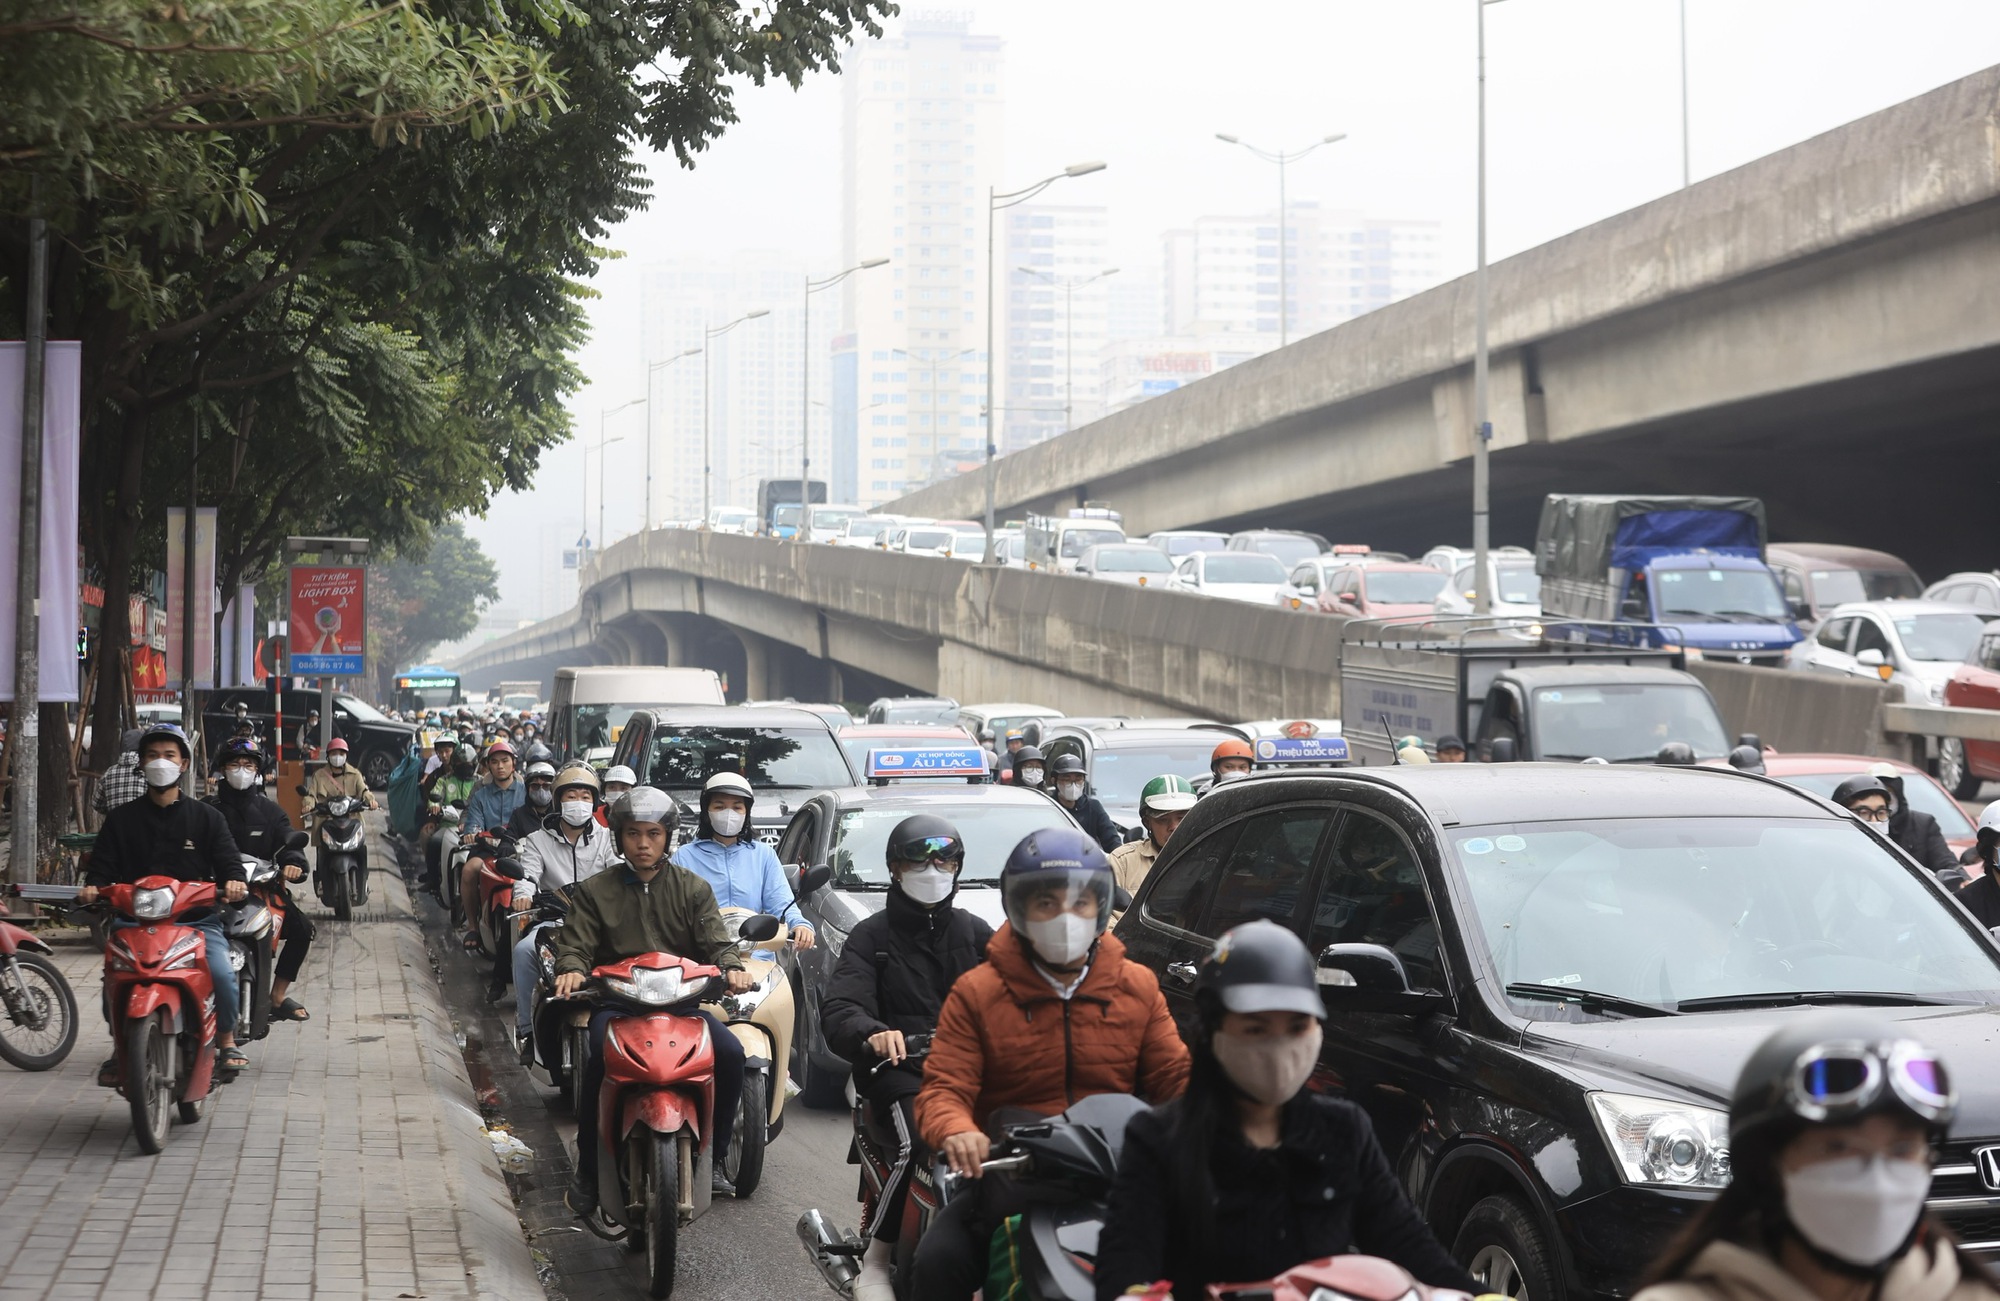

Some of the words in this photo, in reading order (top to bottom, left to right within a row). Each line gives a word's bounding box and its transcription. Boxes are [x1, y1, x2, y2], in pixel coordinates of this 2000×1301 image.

[298, 587, 332, 598] LIGHT
[331, 586, 357, 596] BOX
[1301, 740, 1320, 748] TAXI
[1278, 748, 1302, 758] TRIỆU
[1303, 746, 1327, 756] QUỐC
[1328, 748, 1346, 757] ĐẠT
[912, 758, 935, 768] ÂU
[941, 758, 972, 769] LẠC
[1041, 860, 1083, 868] HONDA
